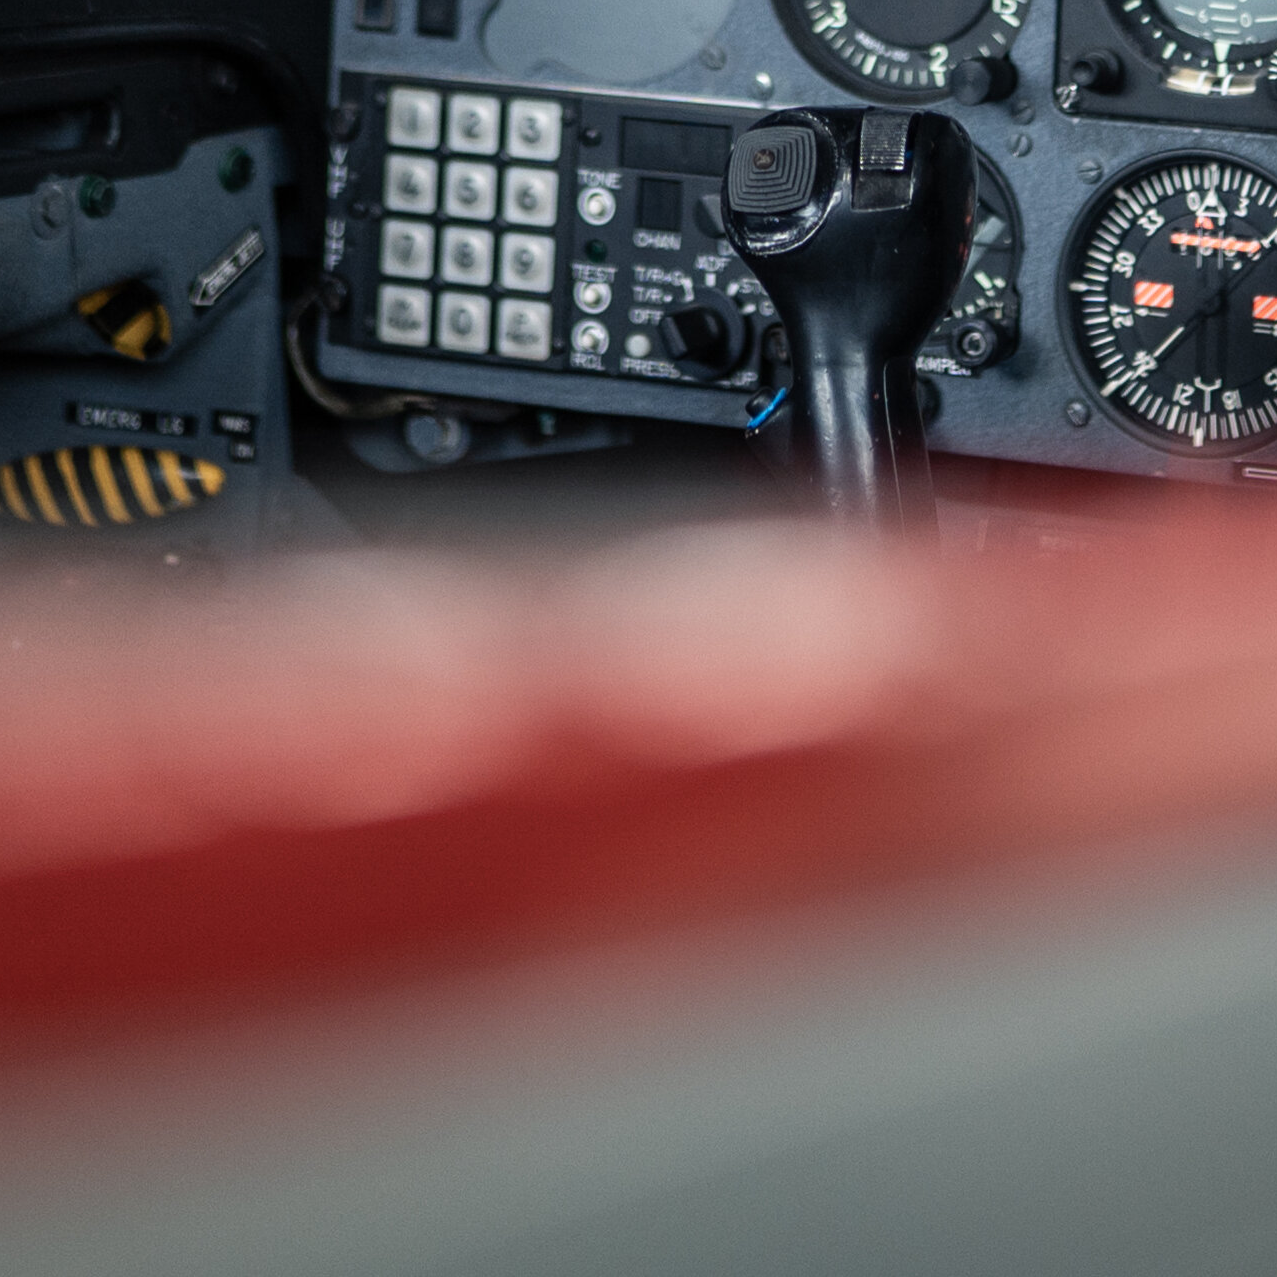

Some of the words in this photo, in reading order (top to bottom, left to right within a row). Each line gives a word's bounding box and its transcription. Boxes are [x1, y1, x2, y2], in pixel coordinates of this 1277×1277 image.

[577, 170, 621, 188] TONE
[1137, 209, 1165, 236] 33
[573, 263, 617, 282] TEST
[1112, 251, 1136, 278] 30
